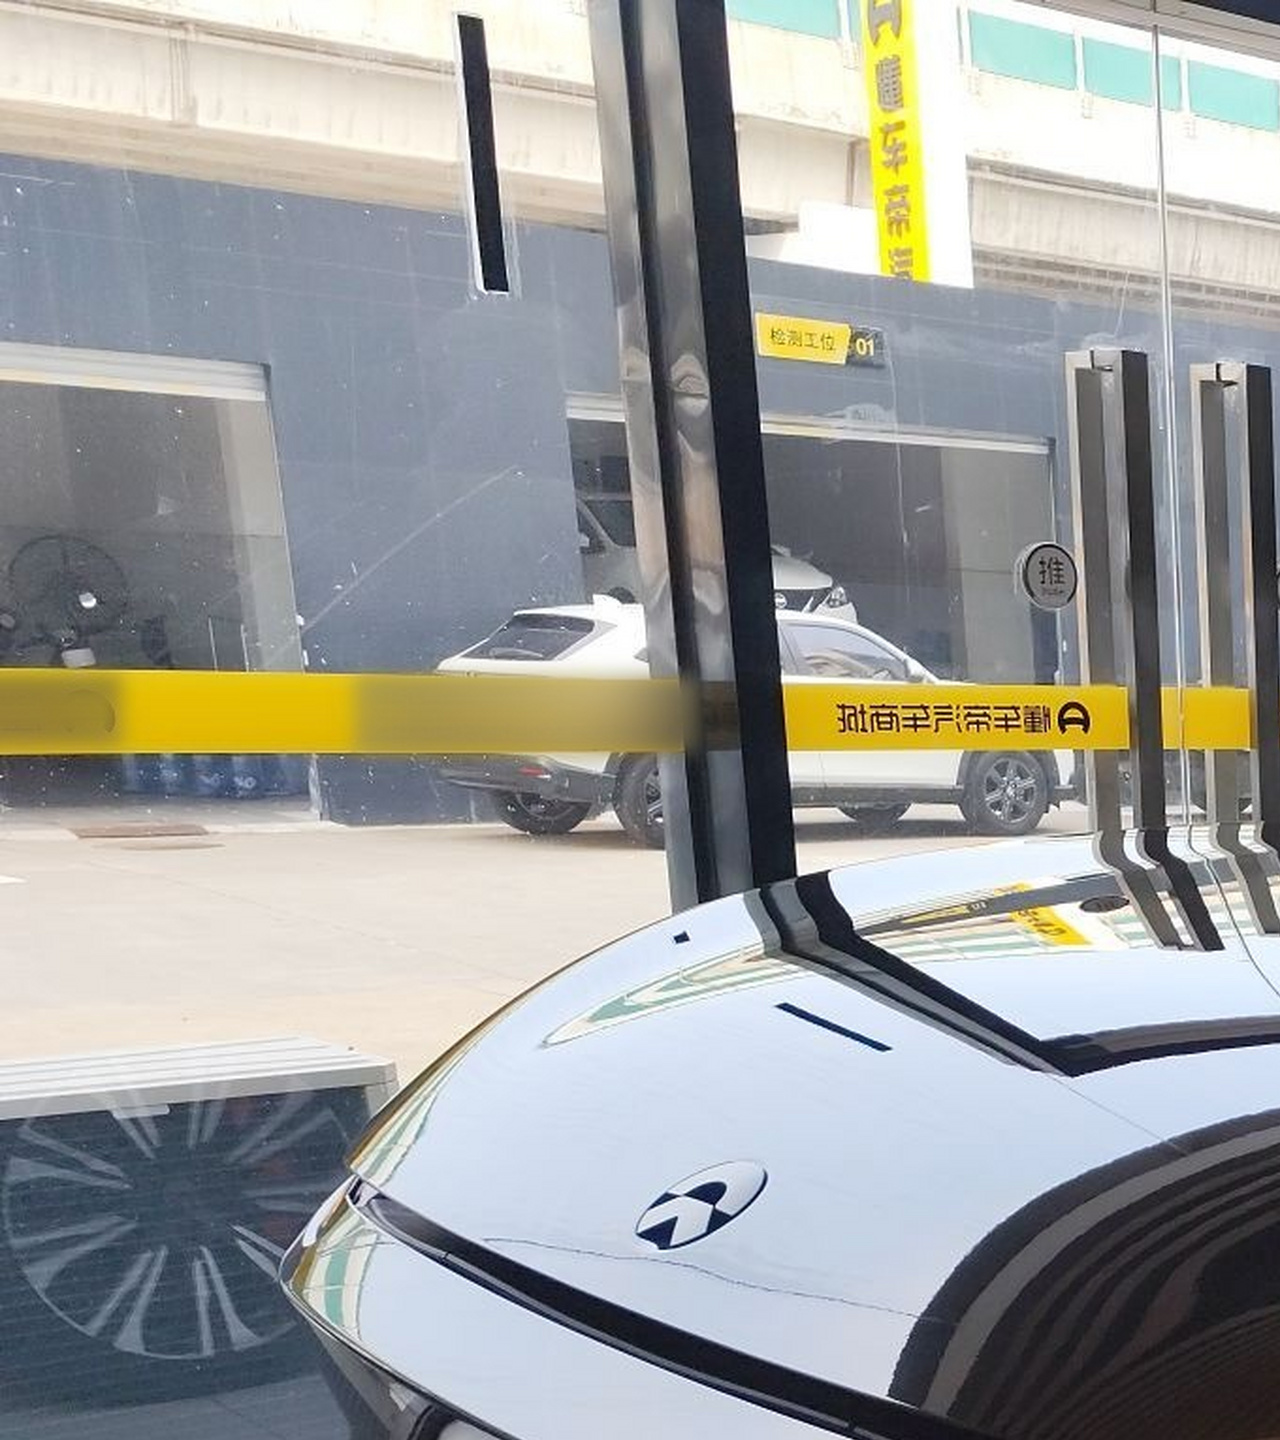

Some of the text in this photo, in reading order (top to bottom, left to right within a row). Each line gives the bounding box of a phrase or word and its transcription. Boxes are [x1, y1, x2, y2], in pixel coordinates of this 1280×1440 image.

[770, 326, 875, 357] 检测工位 01
[1038, 556, 1066, 586] 推
